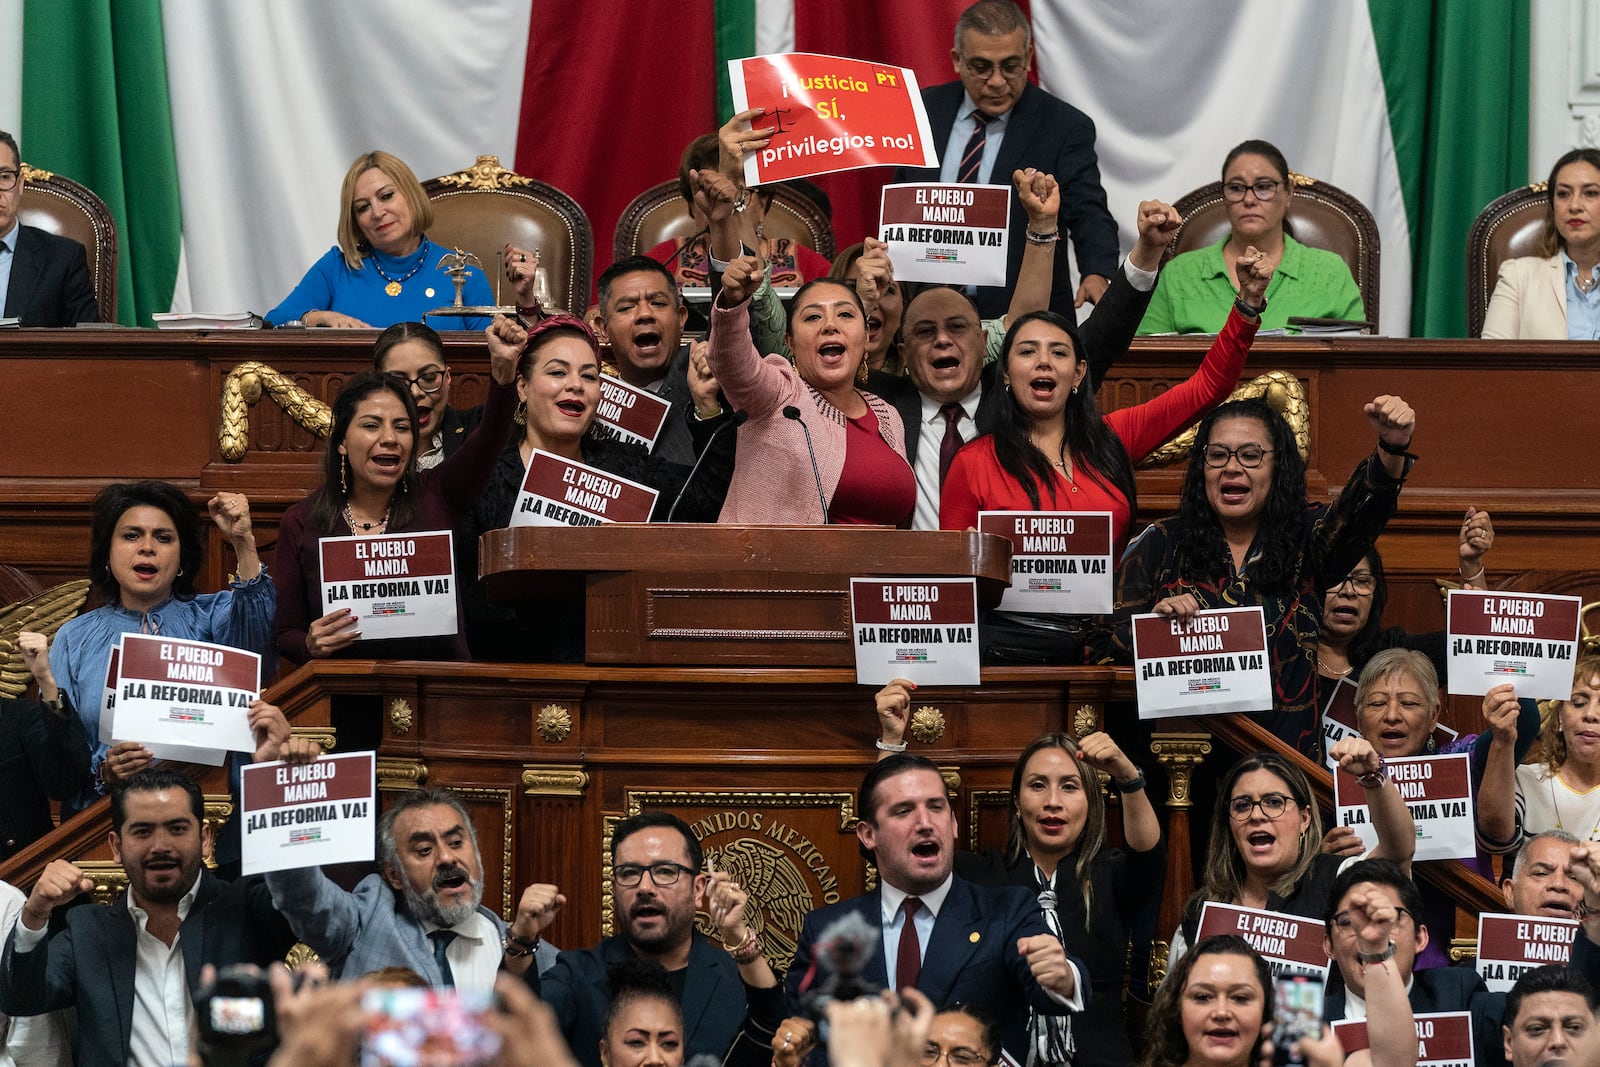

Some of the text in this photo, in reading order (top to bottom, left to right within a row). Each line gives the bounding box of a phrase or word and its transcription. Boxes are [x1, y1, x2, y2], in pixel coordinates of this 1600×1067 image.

[876, 71, 896, 86] PT
[816, 97, 846, 121] SÍ,
[762, 132, 914, 167] privilegios no!
[916, 189, 974, 206] EL PUEBLO
[923, 206, 965, 223] MANDA
[884, 227, 1002, 247] ¡LA REFORMA VA!
[600, 382, 637, 409] PUEBLO
[597, 399, 623, 422] NDA
[562, 467, 622, 500] EL PUEBLO
[520, 496, 543, 514] ¡LA
[564, 486, 608, 514] MANDA
[1015, 518, 1075, 535] EL PUEBLO
[355, 540, 416, 559] EL PUEBLO
[1023, 536, 1067, 552] MANDA
[364, 559, 409, 577] MANDA
[1081, 559, 1106, 574] VA!
[328, 579, 449, 604] ¡LA REFORMA VA!
[882, 586, 939, 602] EL PUEBLO
[890, 604, 932, 621] MANDA
[1483, 598, 1545, 618] EL PUEBLO
[1170, 616, 1229, 636] EL PUEBLO
[1490, 616, 1535, 635] MANDA
[859, 627, 972, 646] ¡LA REFORMA VA!
[1180, 634, 1224, 653] MANDA
[160, 643, 224, 667] EL PUEBLO
[1453, 638, 1572, 660] ¡LA REFORMA VA!
[167, 662, 214, 683] MANDA
[1142, 654, 1263, 681] ¡LA REFORMA VA!
[123, 683, 146, 701] ¡LA
[151, 684, 223, 707] REFORMA
[276, 762, 336, 785] EL PUEBLO
[1387, 763, 1433, 781] PUEBLO
[284, 782, 328, 803] MANDA
[247, 802, 368, 834] ¡LA REFORMA VA!
[1343, 809, 1366, 827] ¡LA
[1441, 802, 1467, 819] VA!
[689, 811, 840, 905] UNIDOS MEXICANO
[1236, 914, 1298, 939] EL PUEBLO
[1517, 923, 1531, 940] EL
[1524, 942, 1570, 962] MANDA
[1482, 964, 1504, 982] ¡LA
